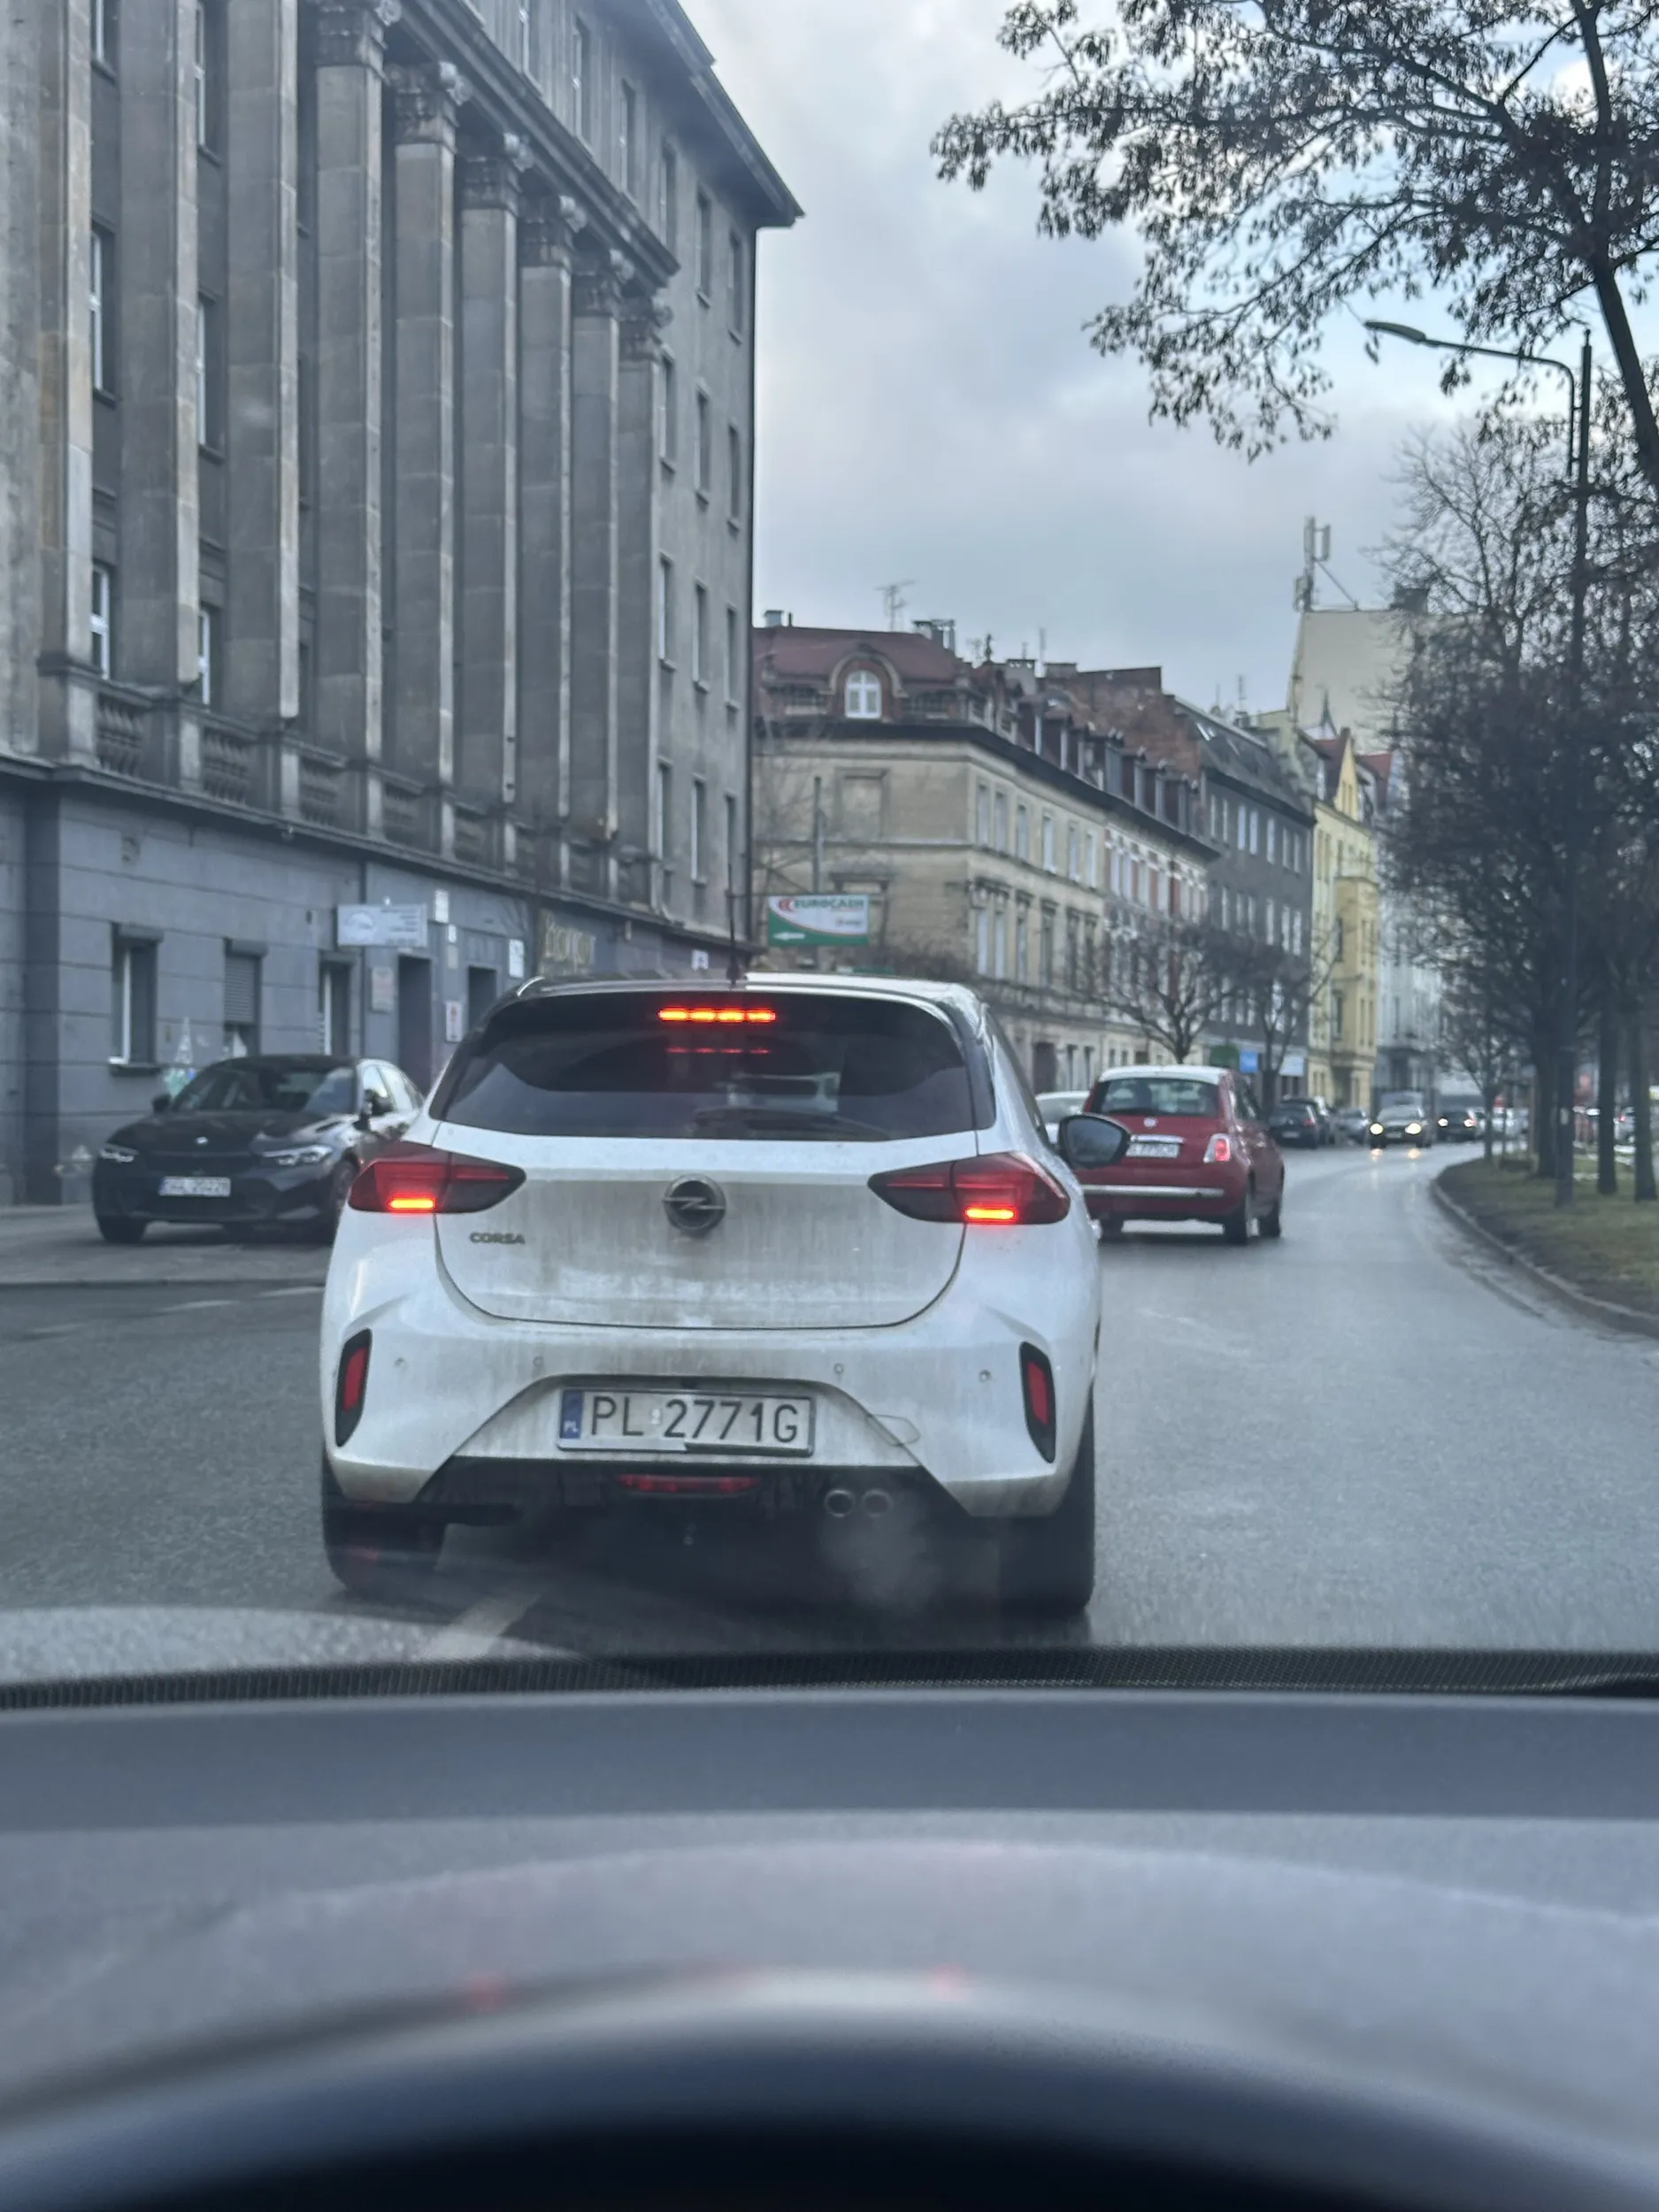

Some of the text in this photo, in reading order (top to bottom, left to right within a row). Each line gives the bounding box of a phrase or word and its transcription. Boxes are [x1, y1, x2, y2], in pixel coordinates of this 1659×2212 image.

[469, 1232, 526, 1245] CORSA
[591, 1395, 799, 1444] PL 2771G
